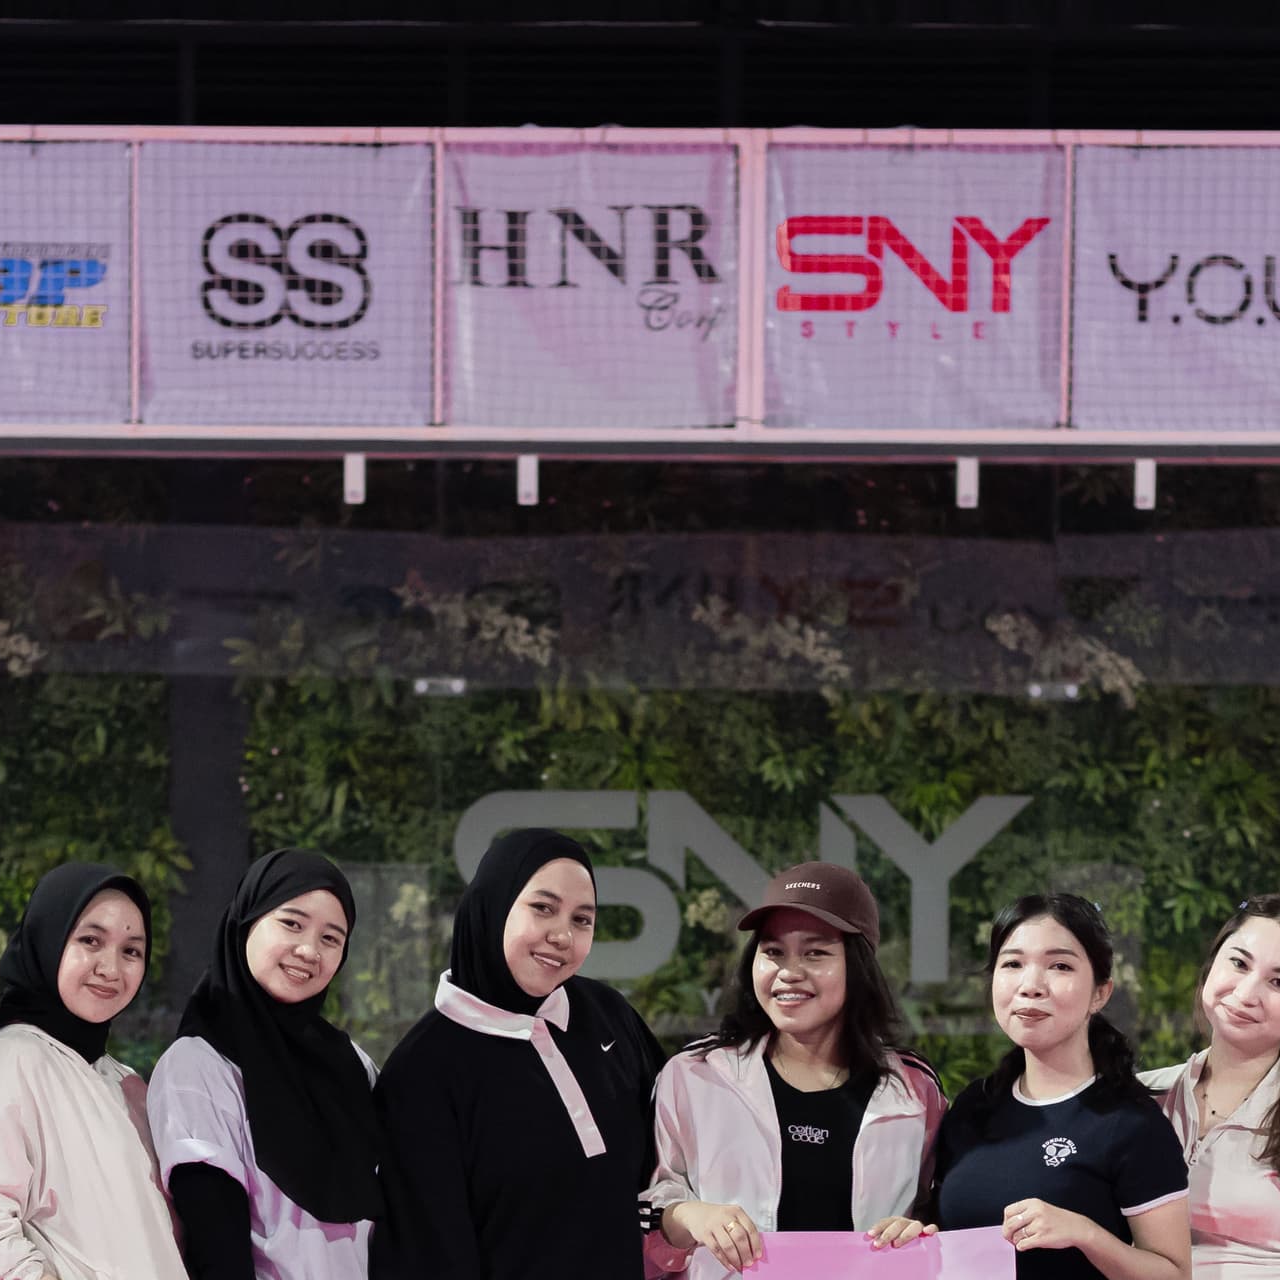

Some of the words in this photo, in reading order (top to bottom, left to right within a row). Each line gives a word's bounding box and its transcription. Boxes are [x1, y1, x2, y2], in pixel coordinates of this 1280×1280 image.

[202, 212, 372, 330] SS
[455, 204, 721, 289] HNR
[776, 215, 1051, 313] SNY
[191, 341, 381, 361] SUPERSUCCESS
[800, 321, 986, 341] STYLE
